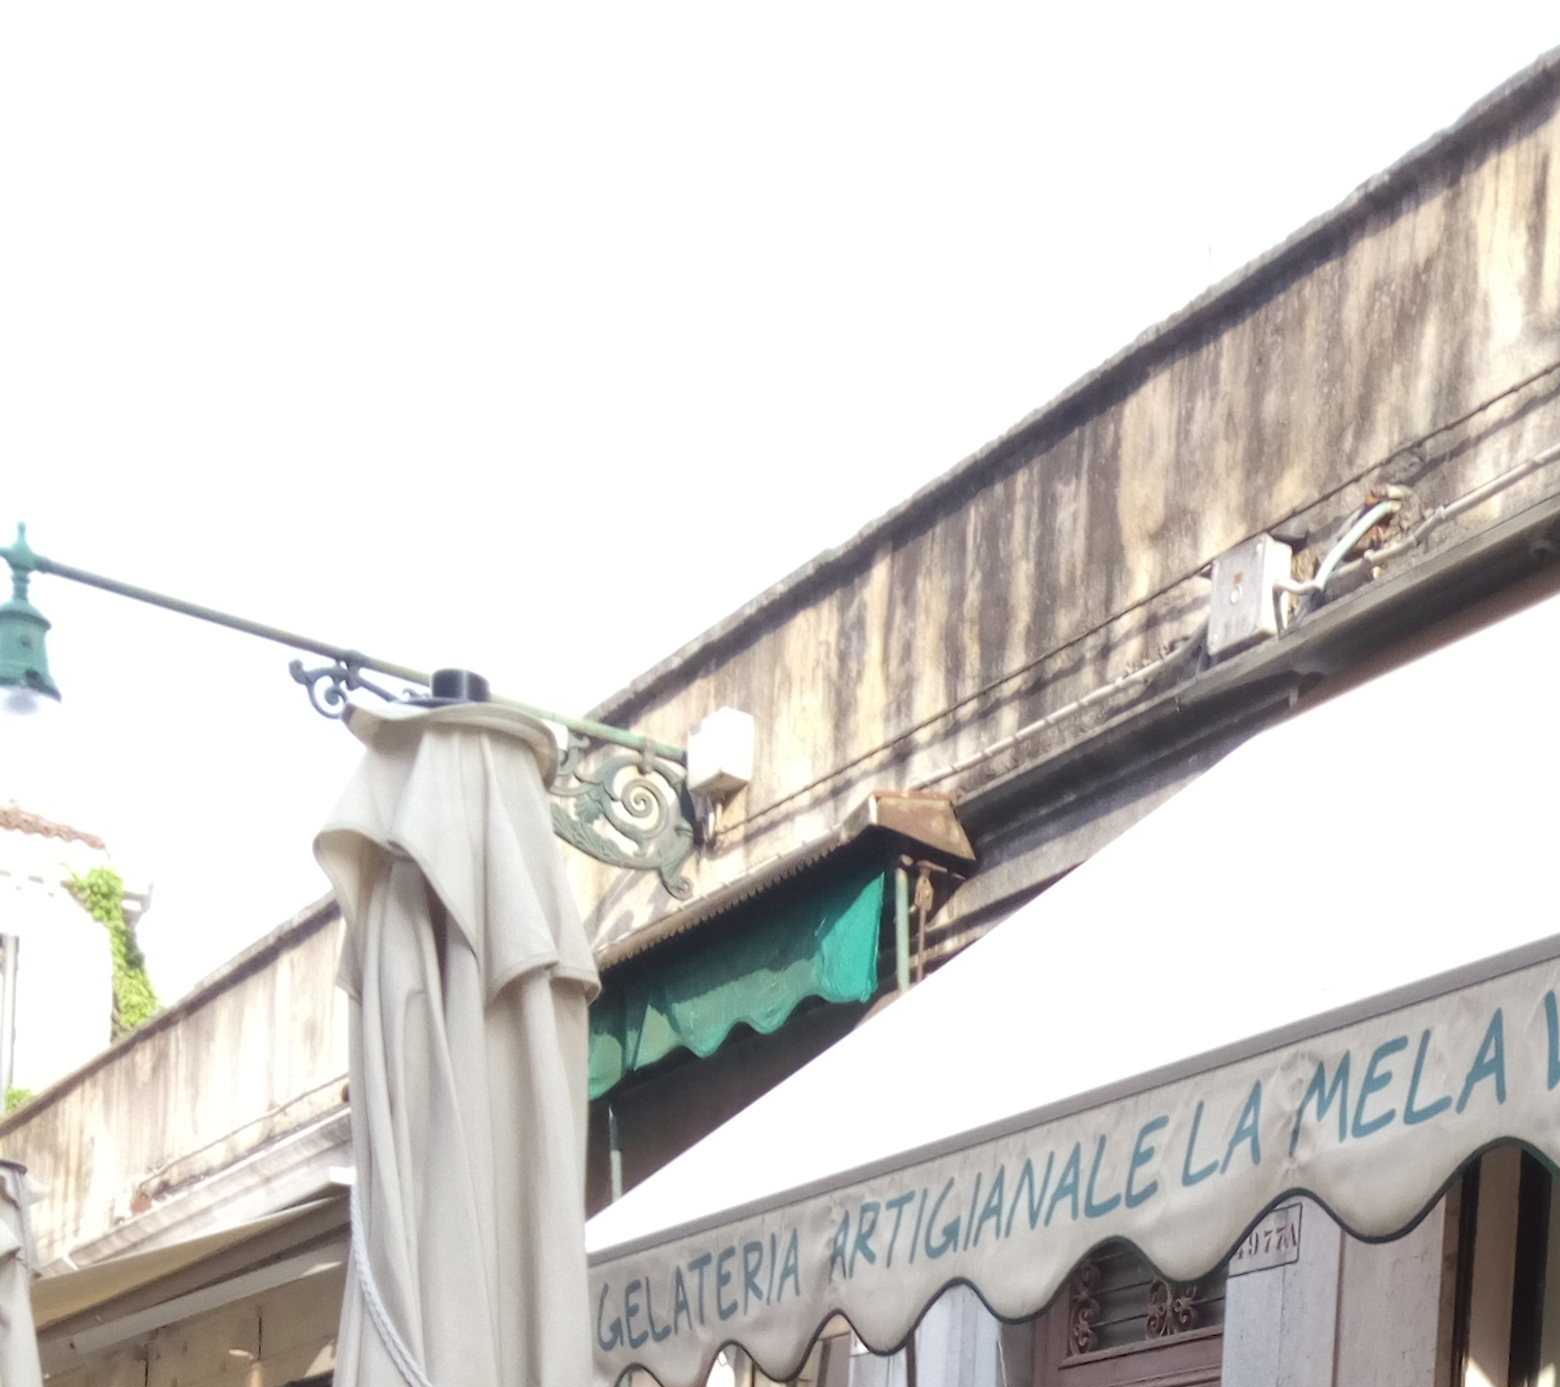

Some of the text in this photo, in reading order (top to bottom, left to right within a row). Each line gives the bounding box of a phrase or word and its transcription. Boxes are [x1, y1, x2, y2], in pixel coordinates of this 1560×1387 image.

[599, 1226, 801, 1352] GELATERIA
[831, 1115, 1168, 1281] ARTIGIANALE
[1182, 1080, 1262, 1188] LA
[1288, 1006, 1508, 1157] MELA
